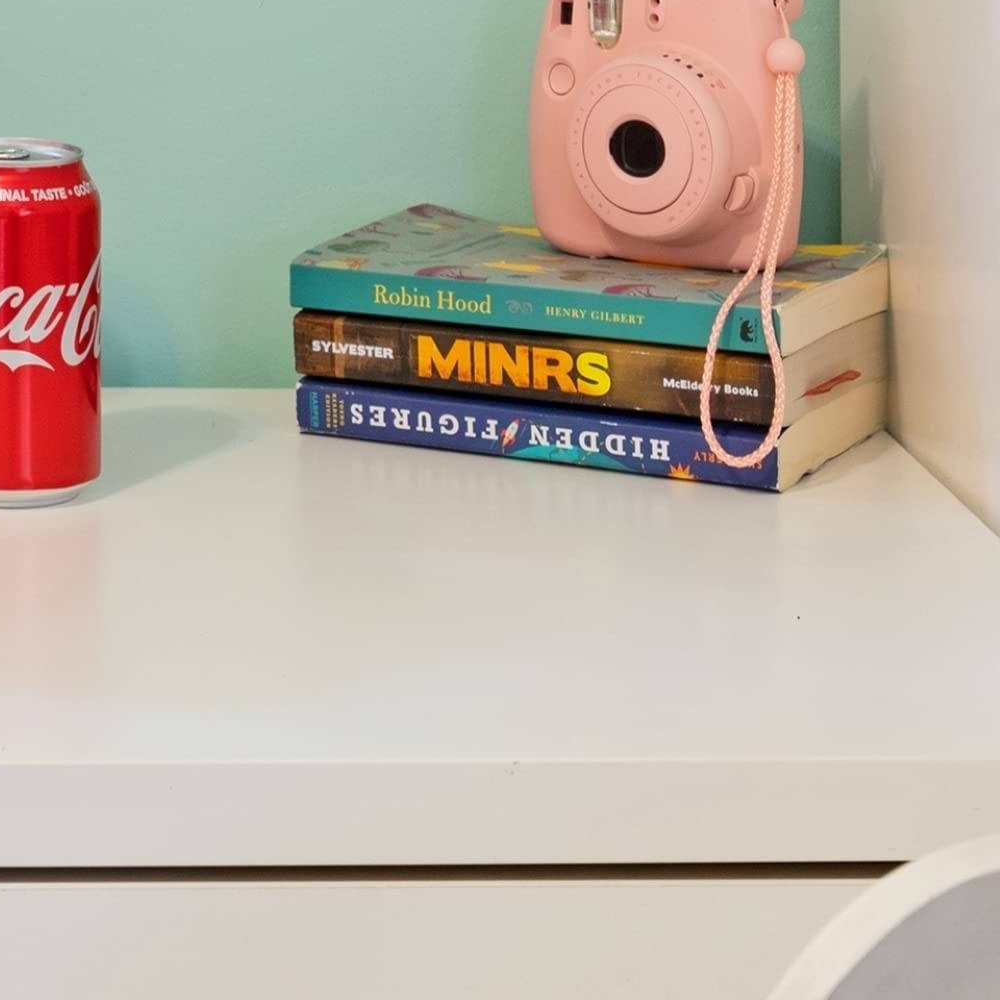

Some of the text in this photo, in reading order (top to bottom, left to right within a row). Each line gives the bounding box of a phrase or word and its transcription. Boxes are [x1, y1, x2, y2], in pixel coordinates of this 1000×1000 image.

[31, 187, 68, 201] TASTE
[374, 284, 492, 315] Robin Hood
[545, 306, 646, 325] HENRY GILBERT
[311, 340, 394, 360] SYLVESTER
[417, 334, 612, 396] MINRS
[724, 384, 759, 398] Books
[350, 403, 500, 441] FIGURES
[528, 424, 671, 462] HIDDEN
